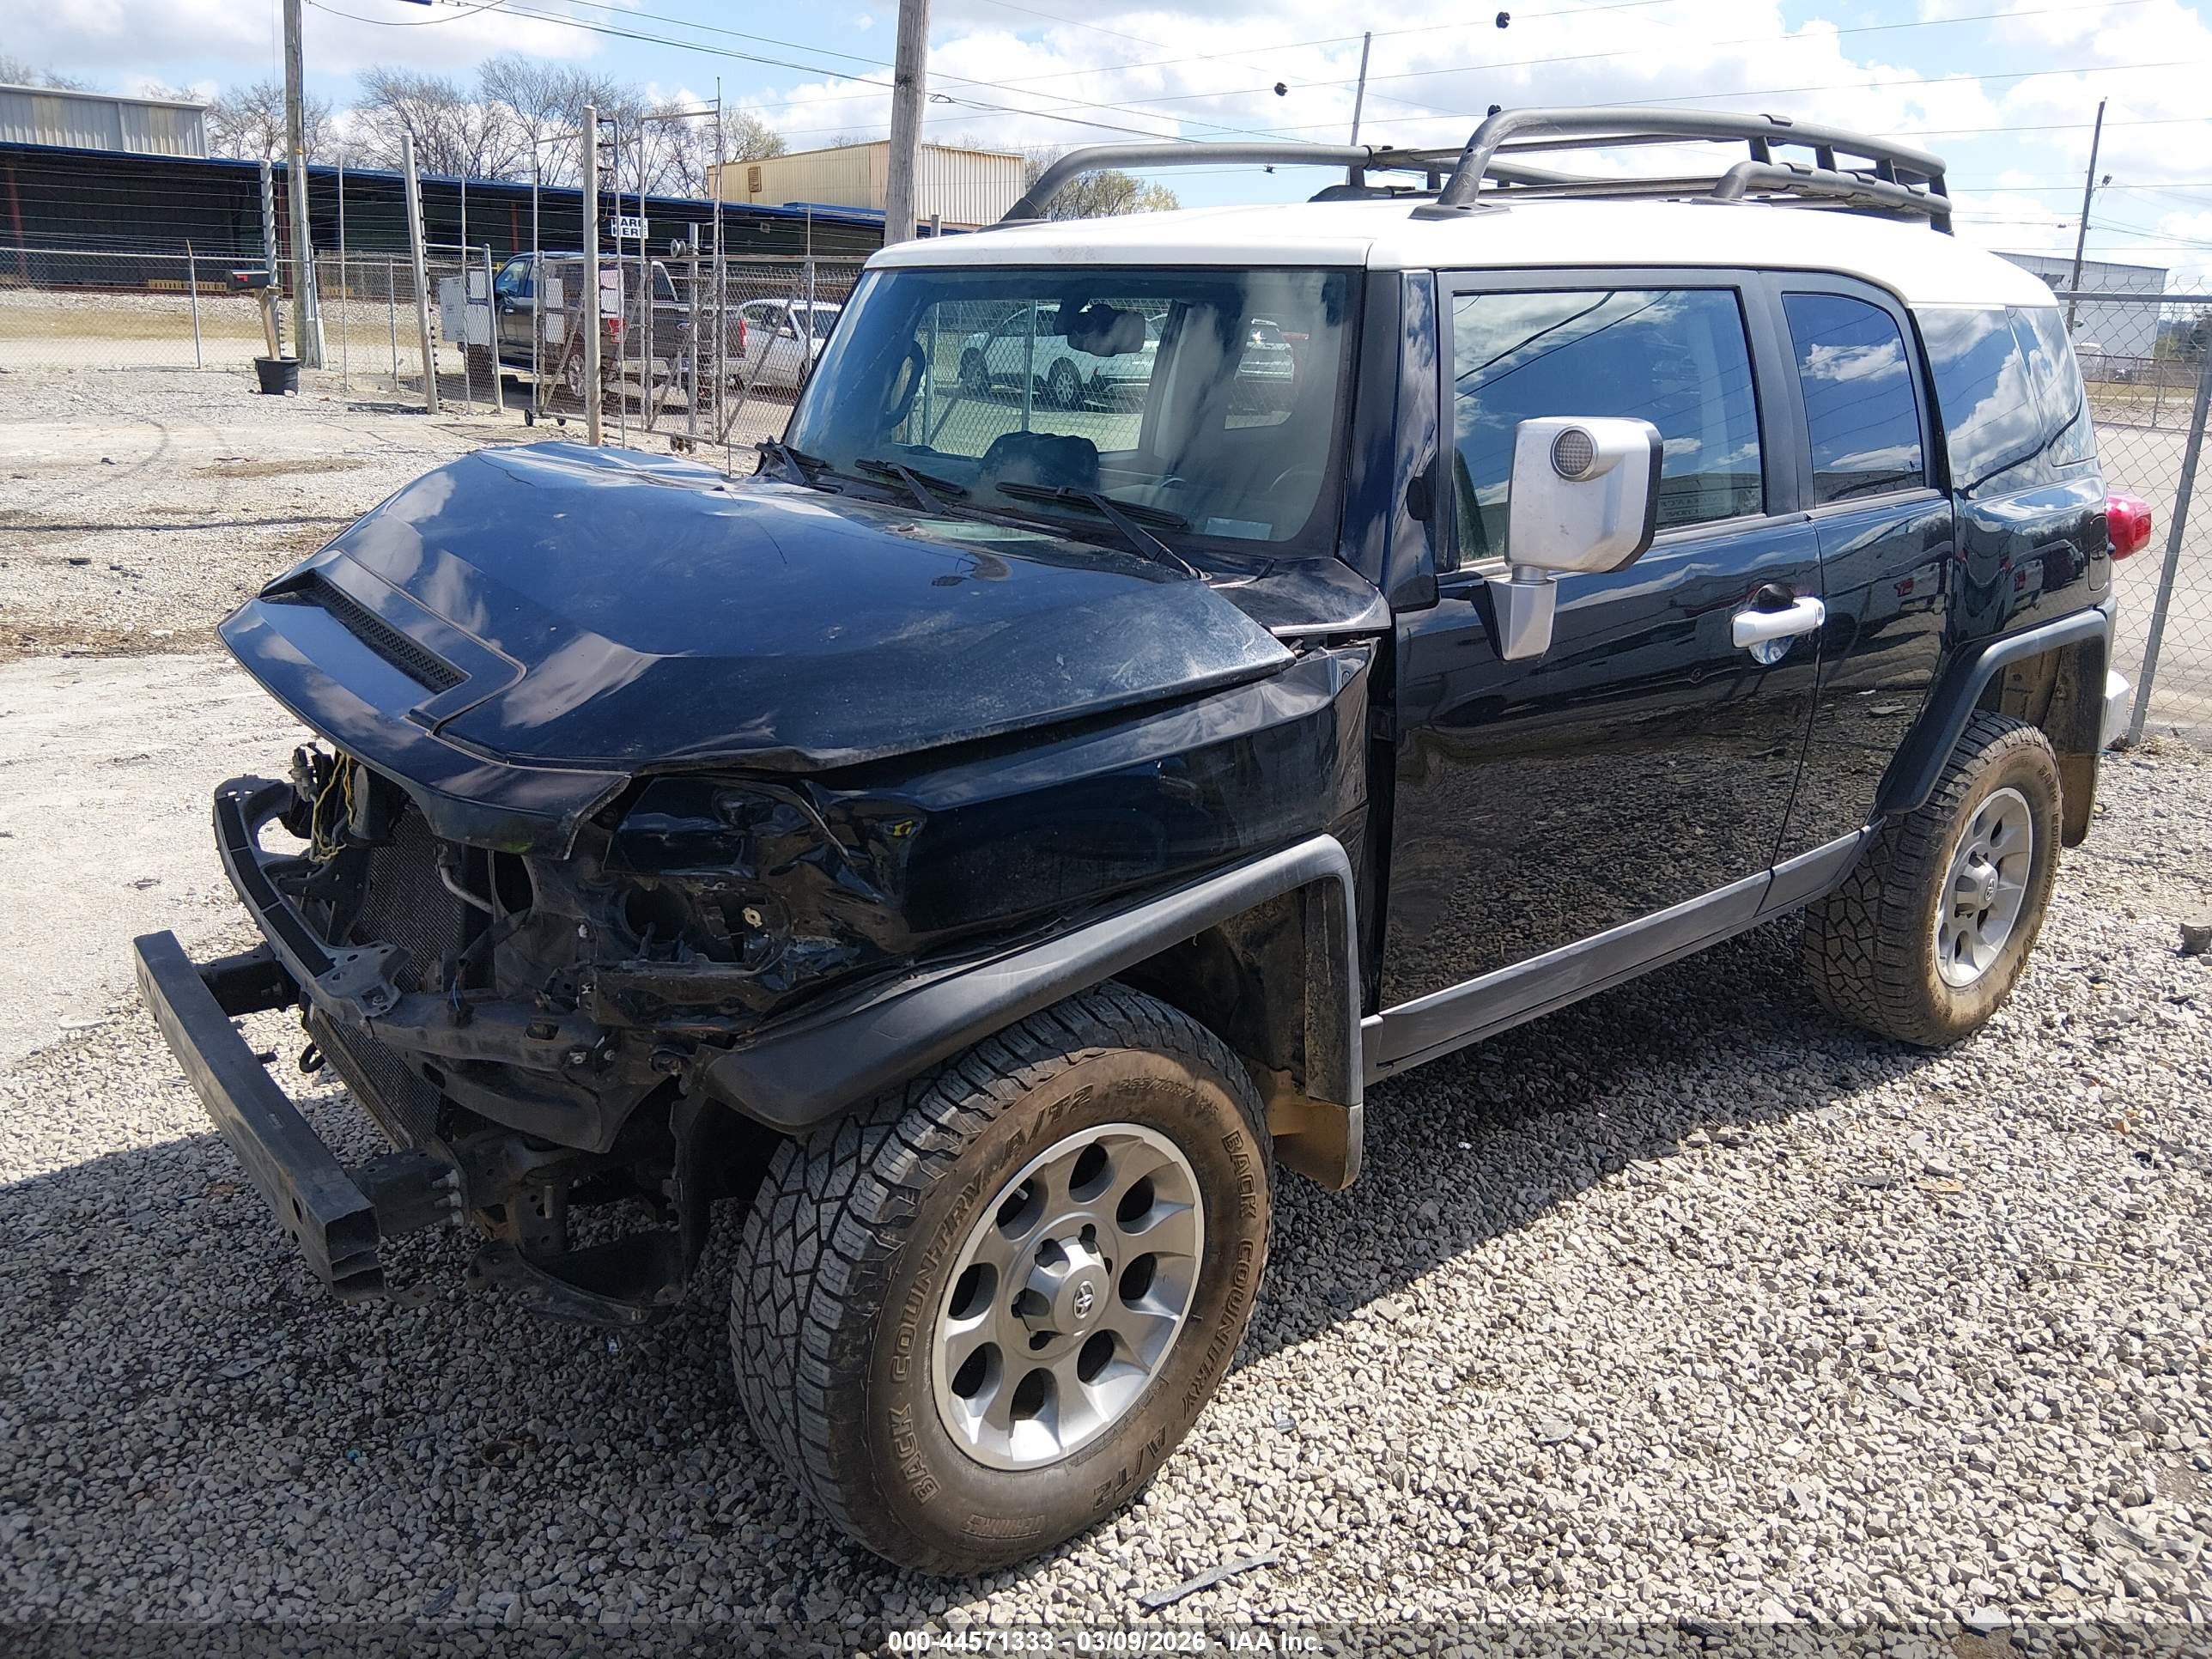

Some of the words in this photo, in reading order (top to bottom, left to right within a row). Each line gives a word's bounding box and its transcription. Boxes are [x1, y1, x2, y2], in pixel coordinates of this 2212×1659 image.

[1221, 1130, 1257, 1218] BACK
[890, 1167, 987, 1382] COUNTRY
[1182, 1238, 1254, 1419] COUNTRY
[888, 1402, 942, 1504] BACK
